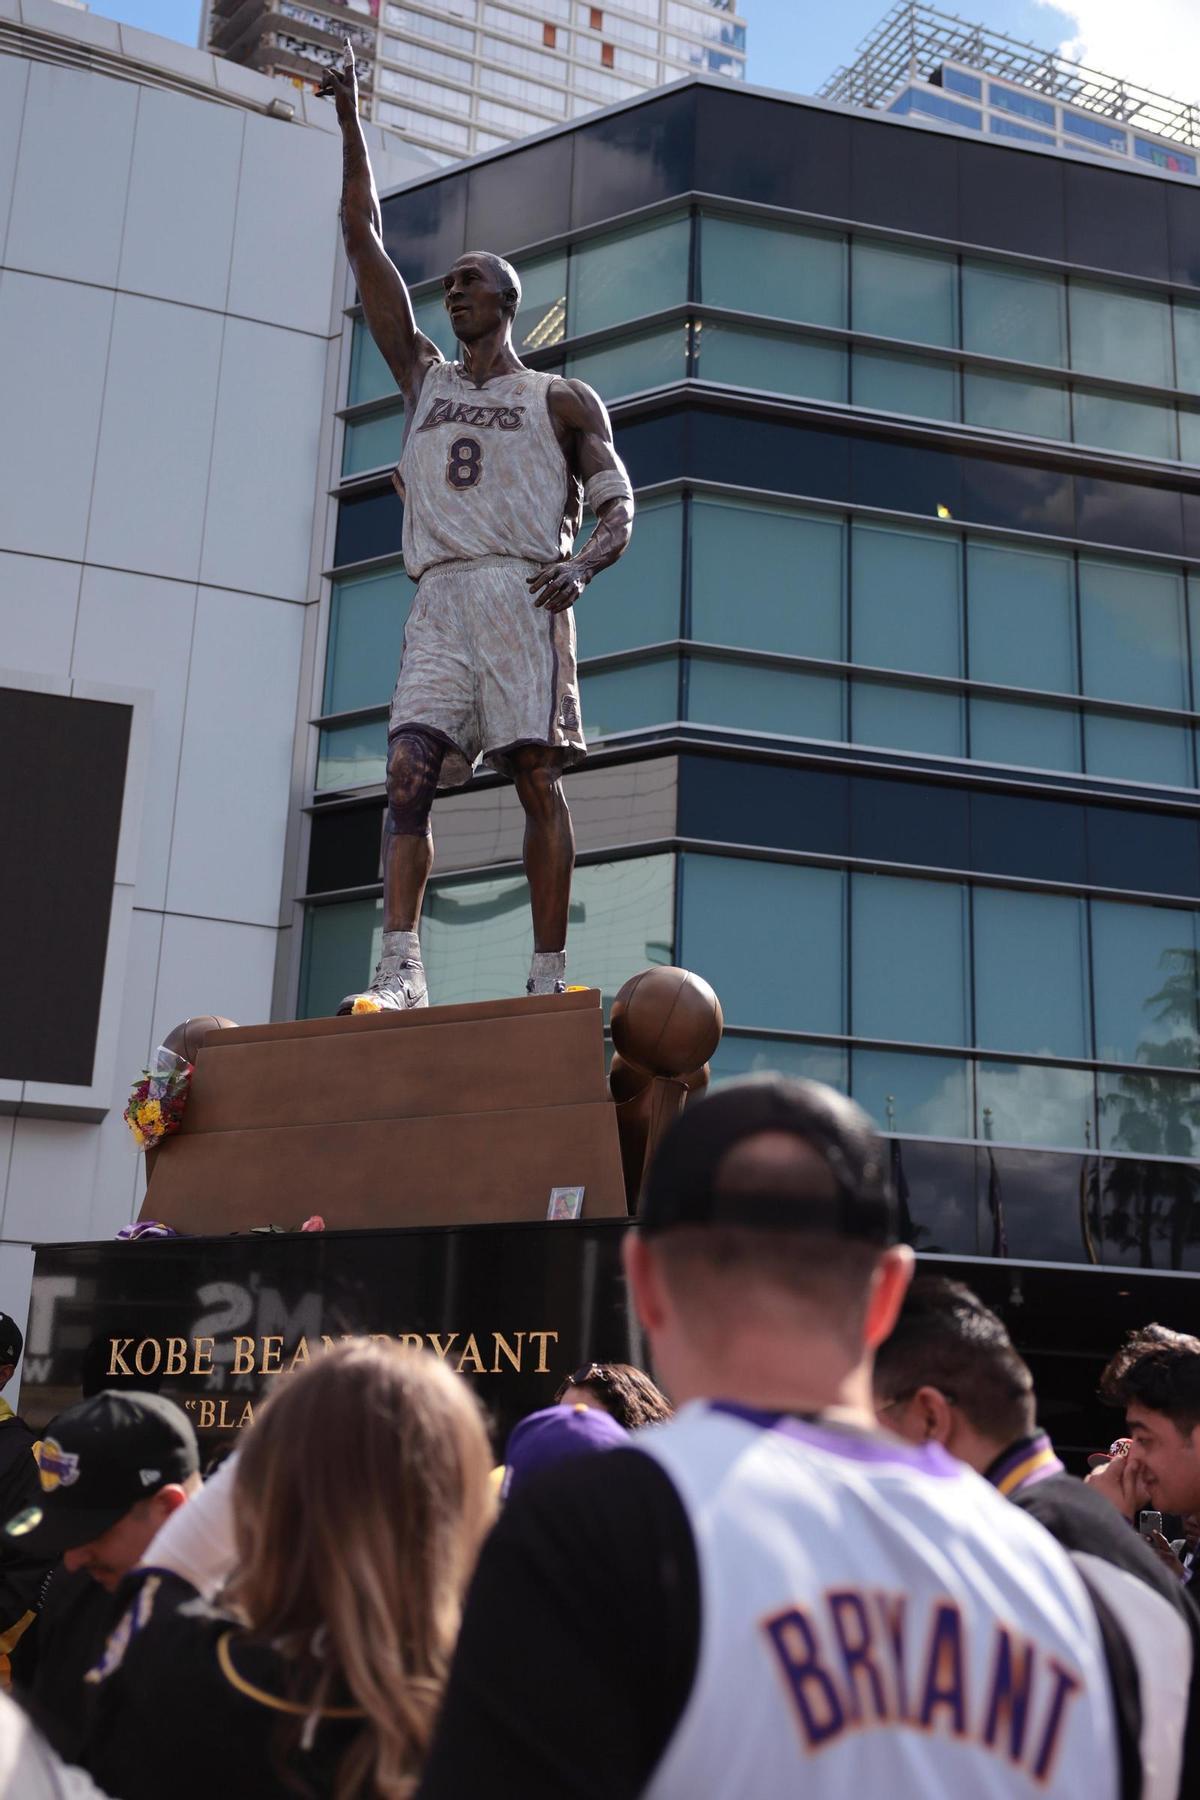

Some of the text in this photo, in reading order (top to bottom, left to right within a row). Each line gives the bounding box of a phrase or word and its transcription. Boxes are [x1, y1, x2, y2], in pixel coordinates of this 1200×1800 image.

[416, 397, 526, 432] LAKERS
[446, 435, 483, 491] 8
[105, 1336, 216, 1376] KOBE
[761, 1588, 1083, 1789] BRYANT
